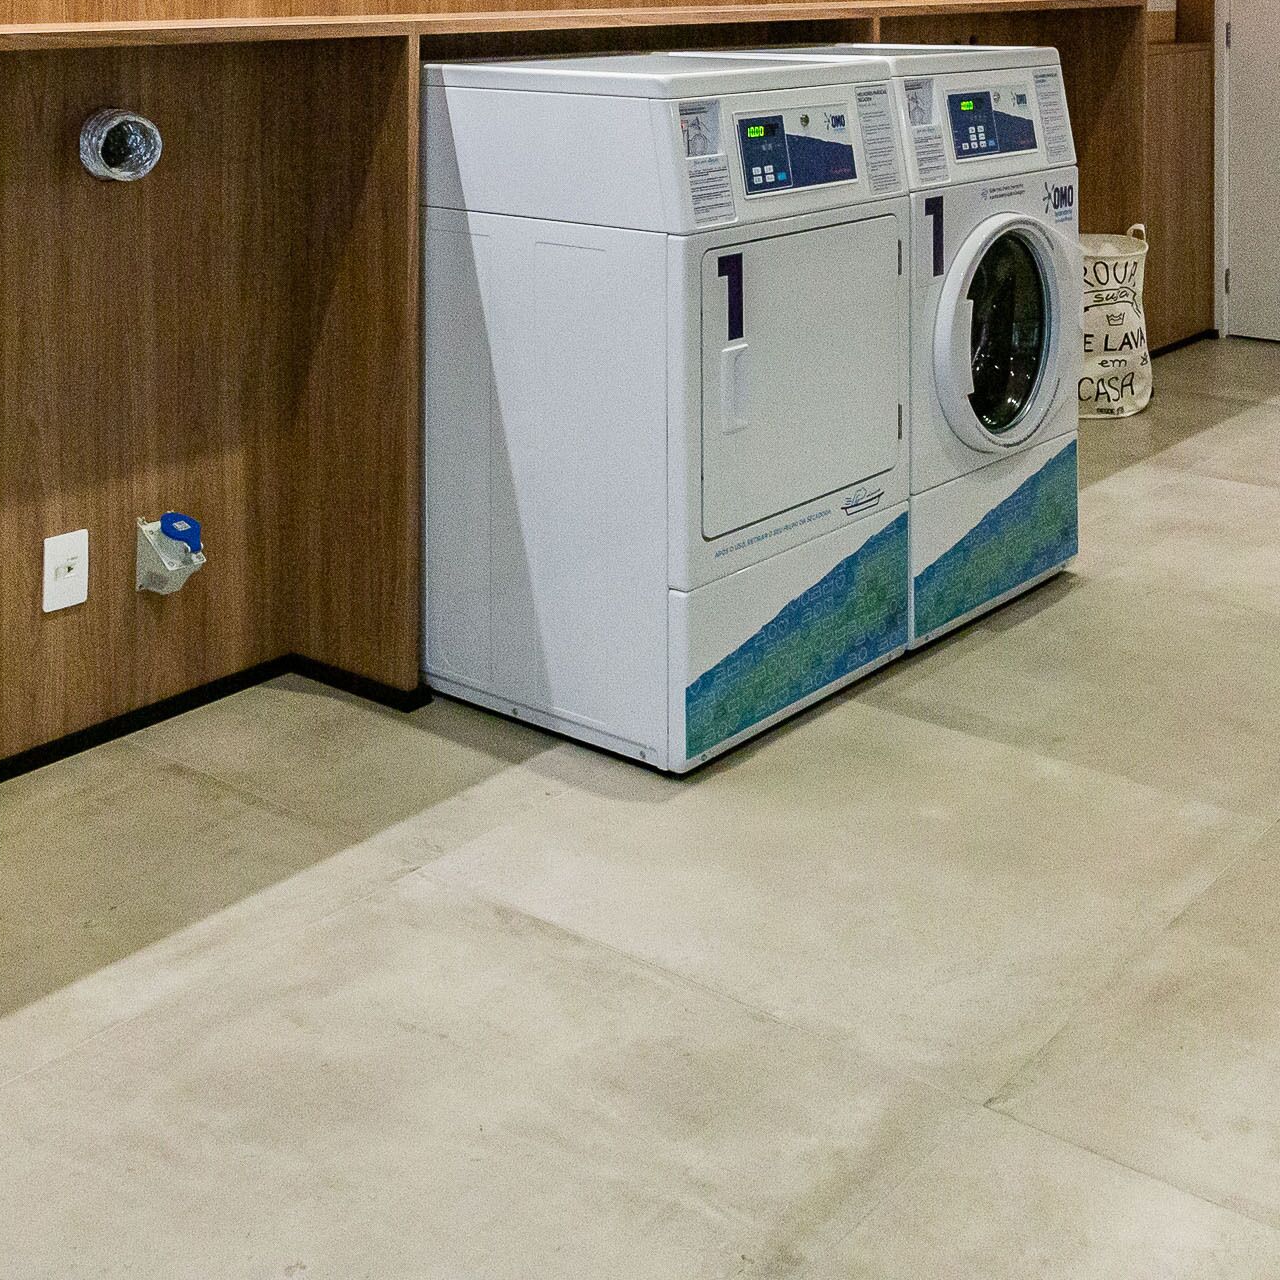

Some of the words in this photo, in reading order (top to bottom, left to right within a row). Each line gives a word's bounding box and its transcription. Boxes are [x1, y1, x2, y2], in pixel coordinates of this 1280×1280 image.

[1053, 185, 1074, 210] OMO
[924, 195, 944, 277] 1
[718, 252, 744, 341] 1
[1093, 289, 1130, 303] suja
[1098, 359, 1128, 368] em
[1078, 371, 1135, 403] CASA
